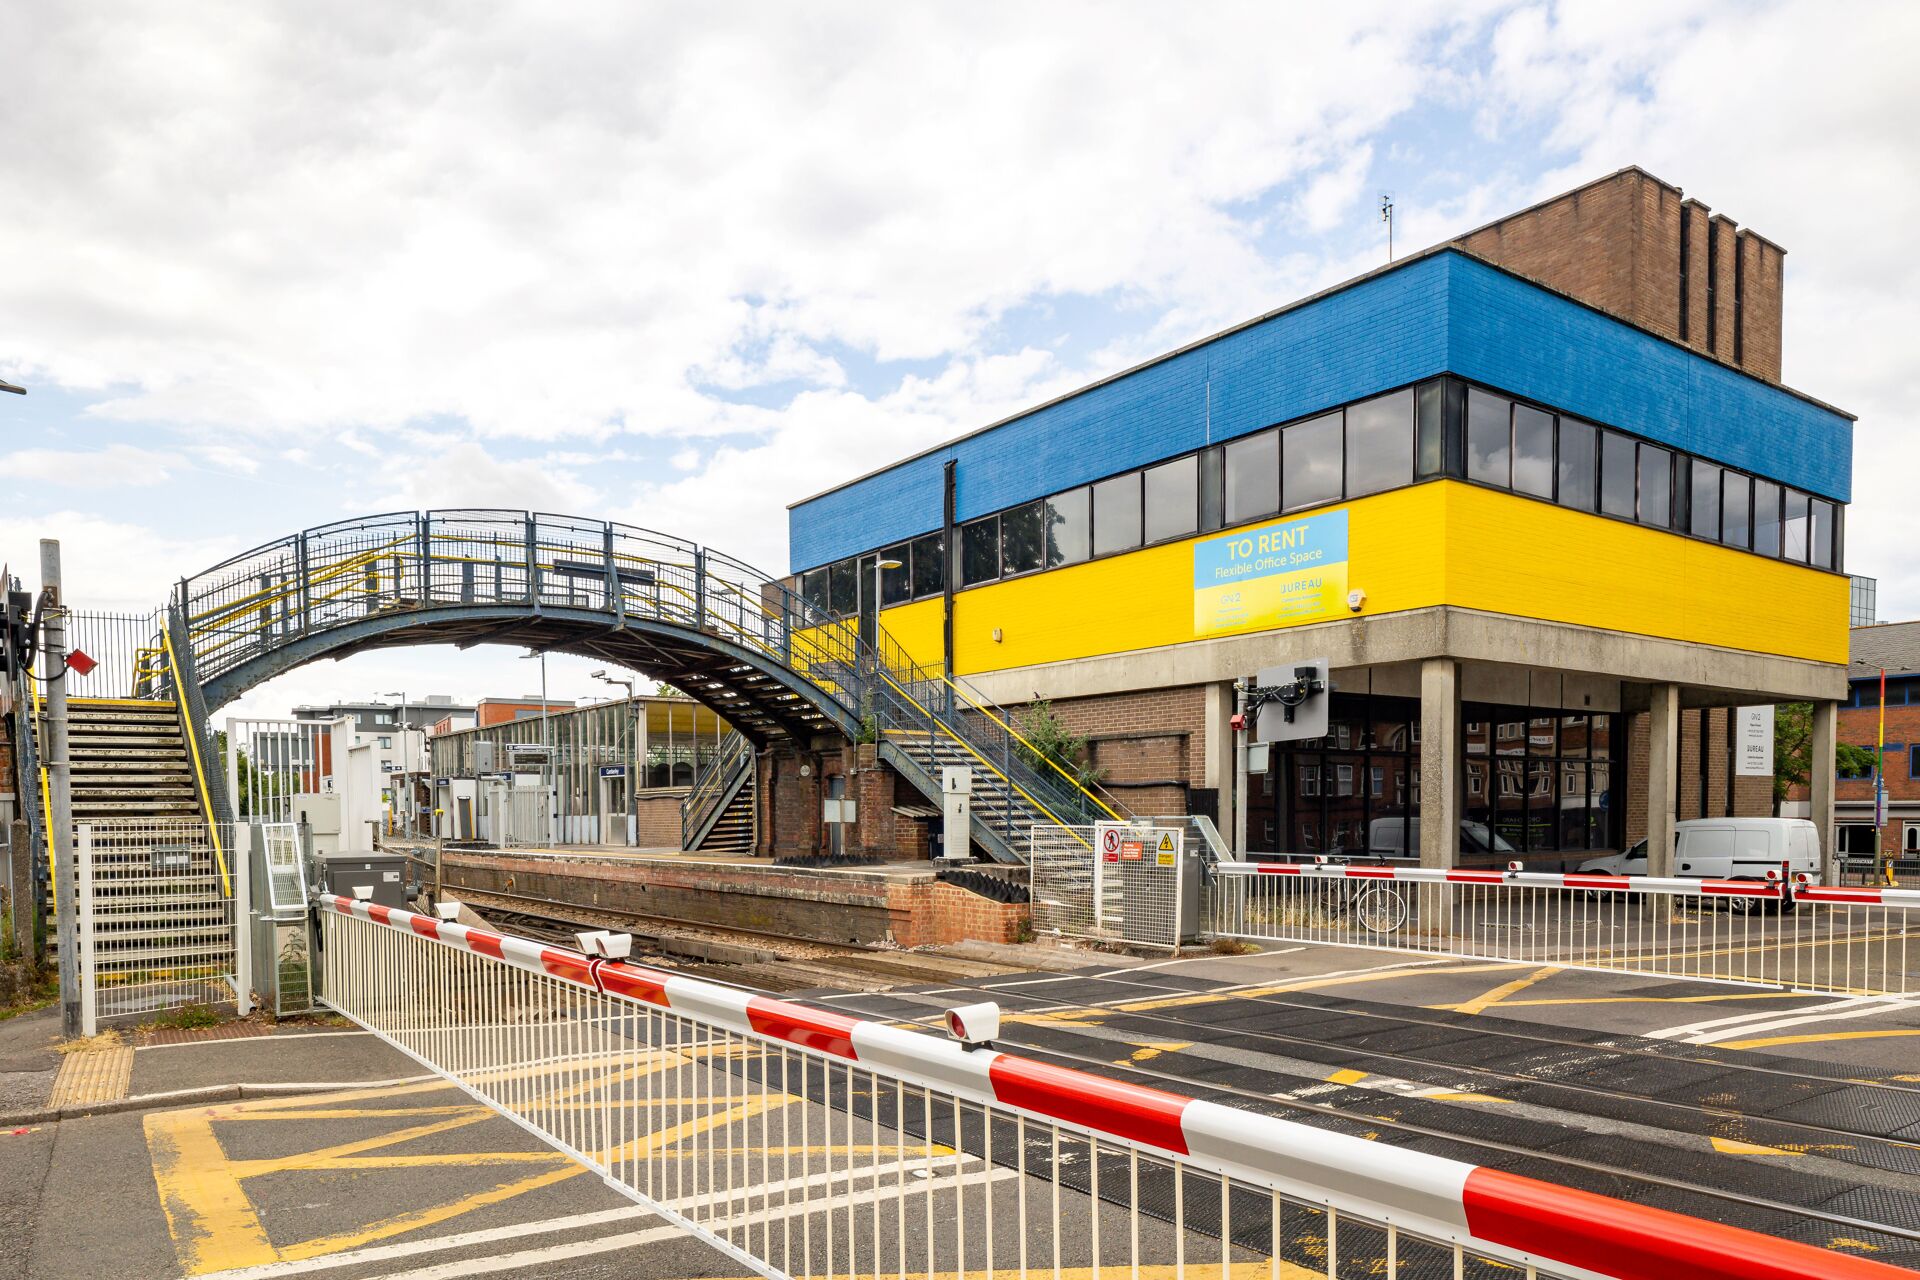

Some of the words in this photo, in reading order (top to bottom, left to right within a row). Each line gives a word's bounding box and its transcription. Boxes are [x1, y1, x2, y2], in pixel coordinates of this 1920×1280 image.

[1227, 539, 1253, 560] TO
[1258, 525, 1309, 554] RENT
[1215, 562, 1252, 579] Flexible
[1255, 556, 1287, 571] Office
[1290, 549, 1323, 566] Space
